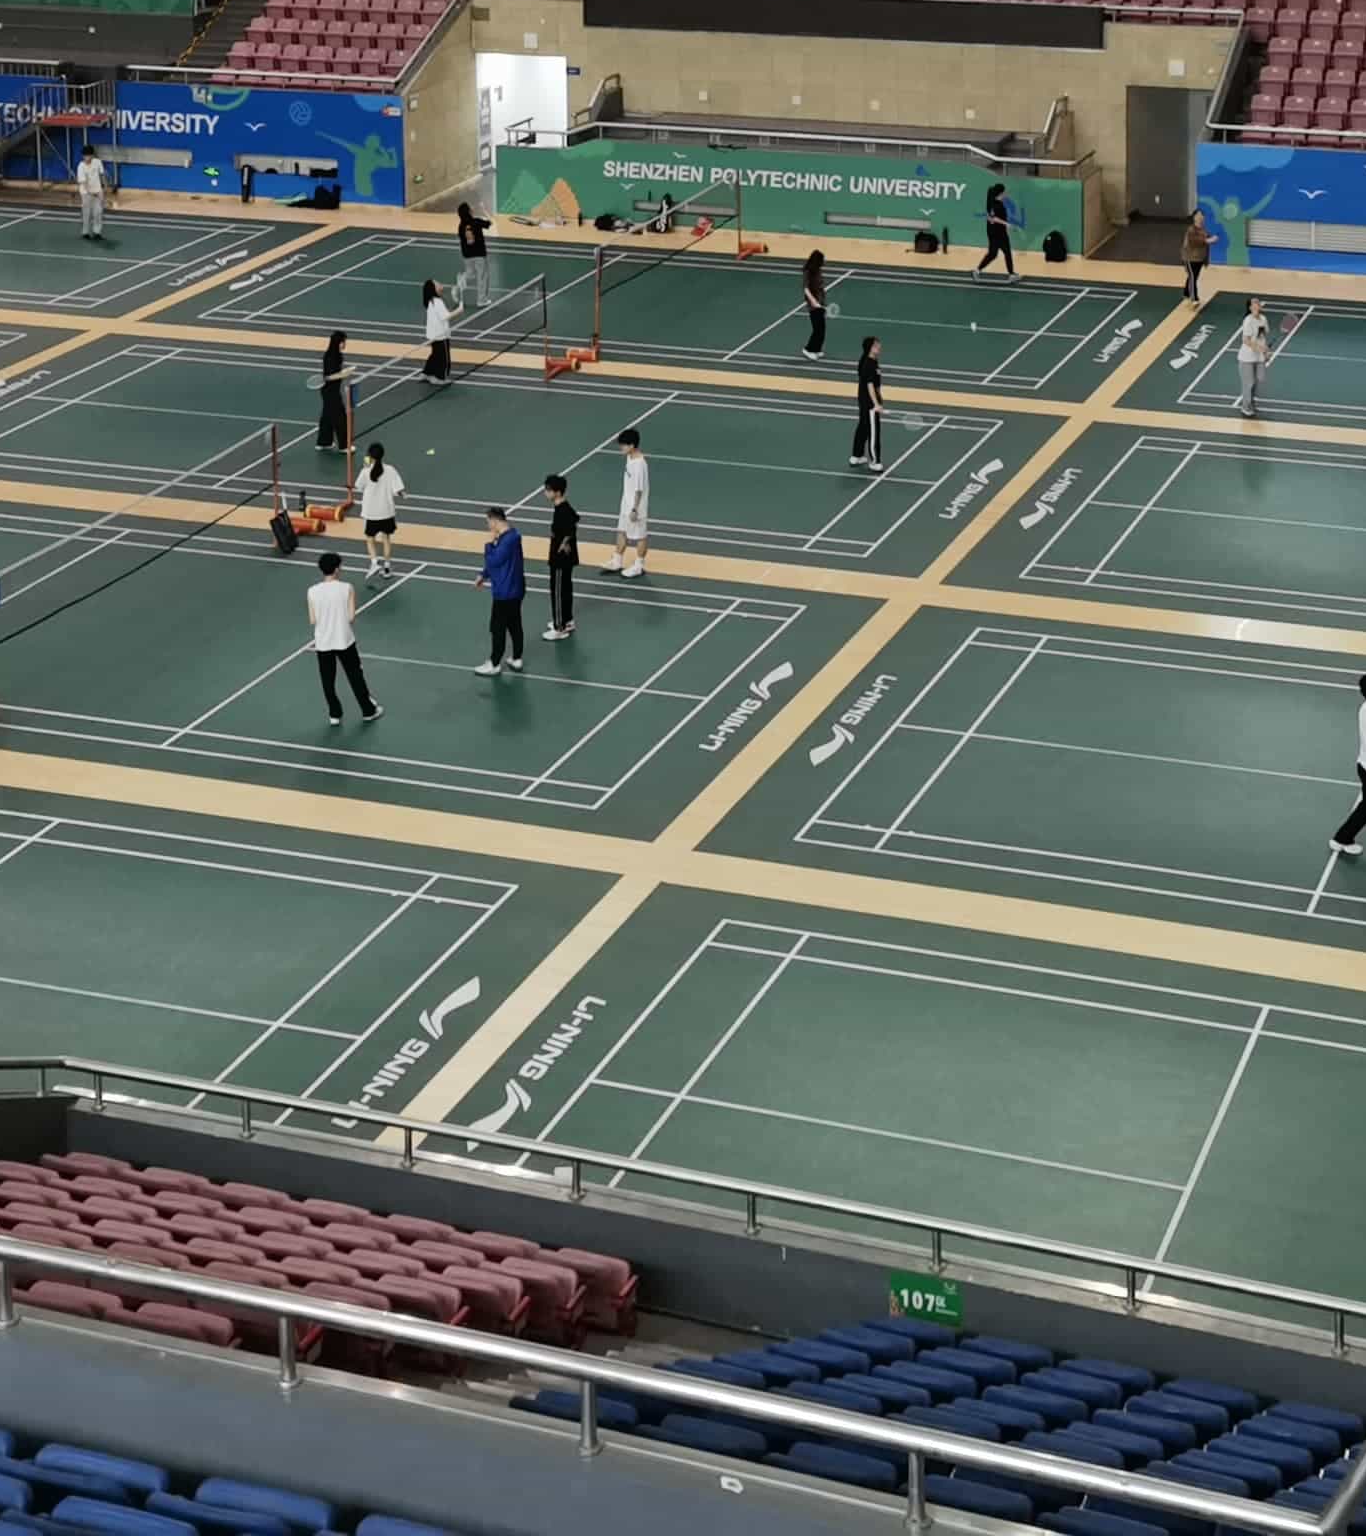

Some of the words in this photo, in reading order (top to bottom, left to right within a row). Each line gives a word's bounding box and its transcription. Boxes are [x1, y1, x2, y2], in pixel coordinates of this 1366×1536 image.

[602, 160, 705, 184] SHENZHEN
[709, 167, 843, 192] POLYTECHNIC
[848, 175, 967, 201] UNIVERSITY
[698, 697, 764, 752] LI-NING
[839, 673, 898, 726] LI-NING
[518, 994, 608, 1082] LI-NING
